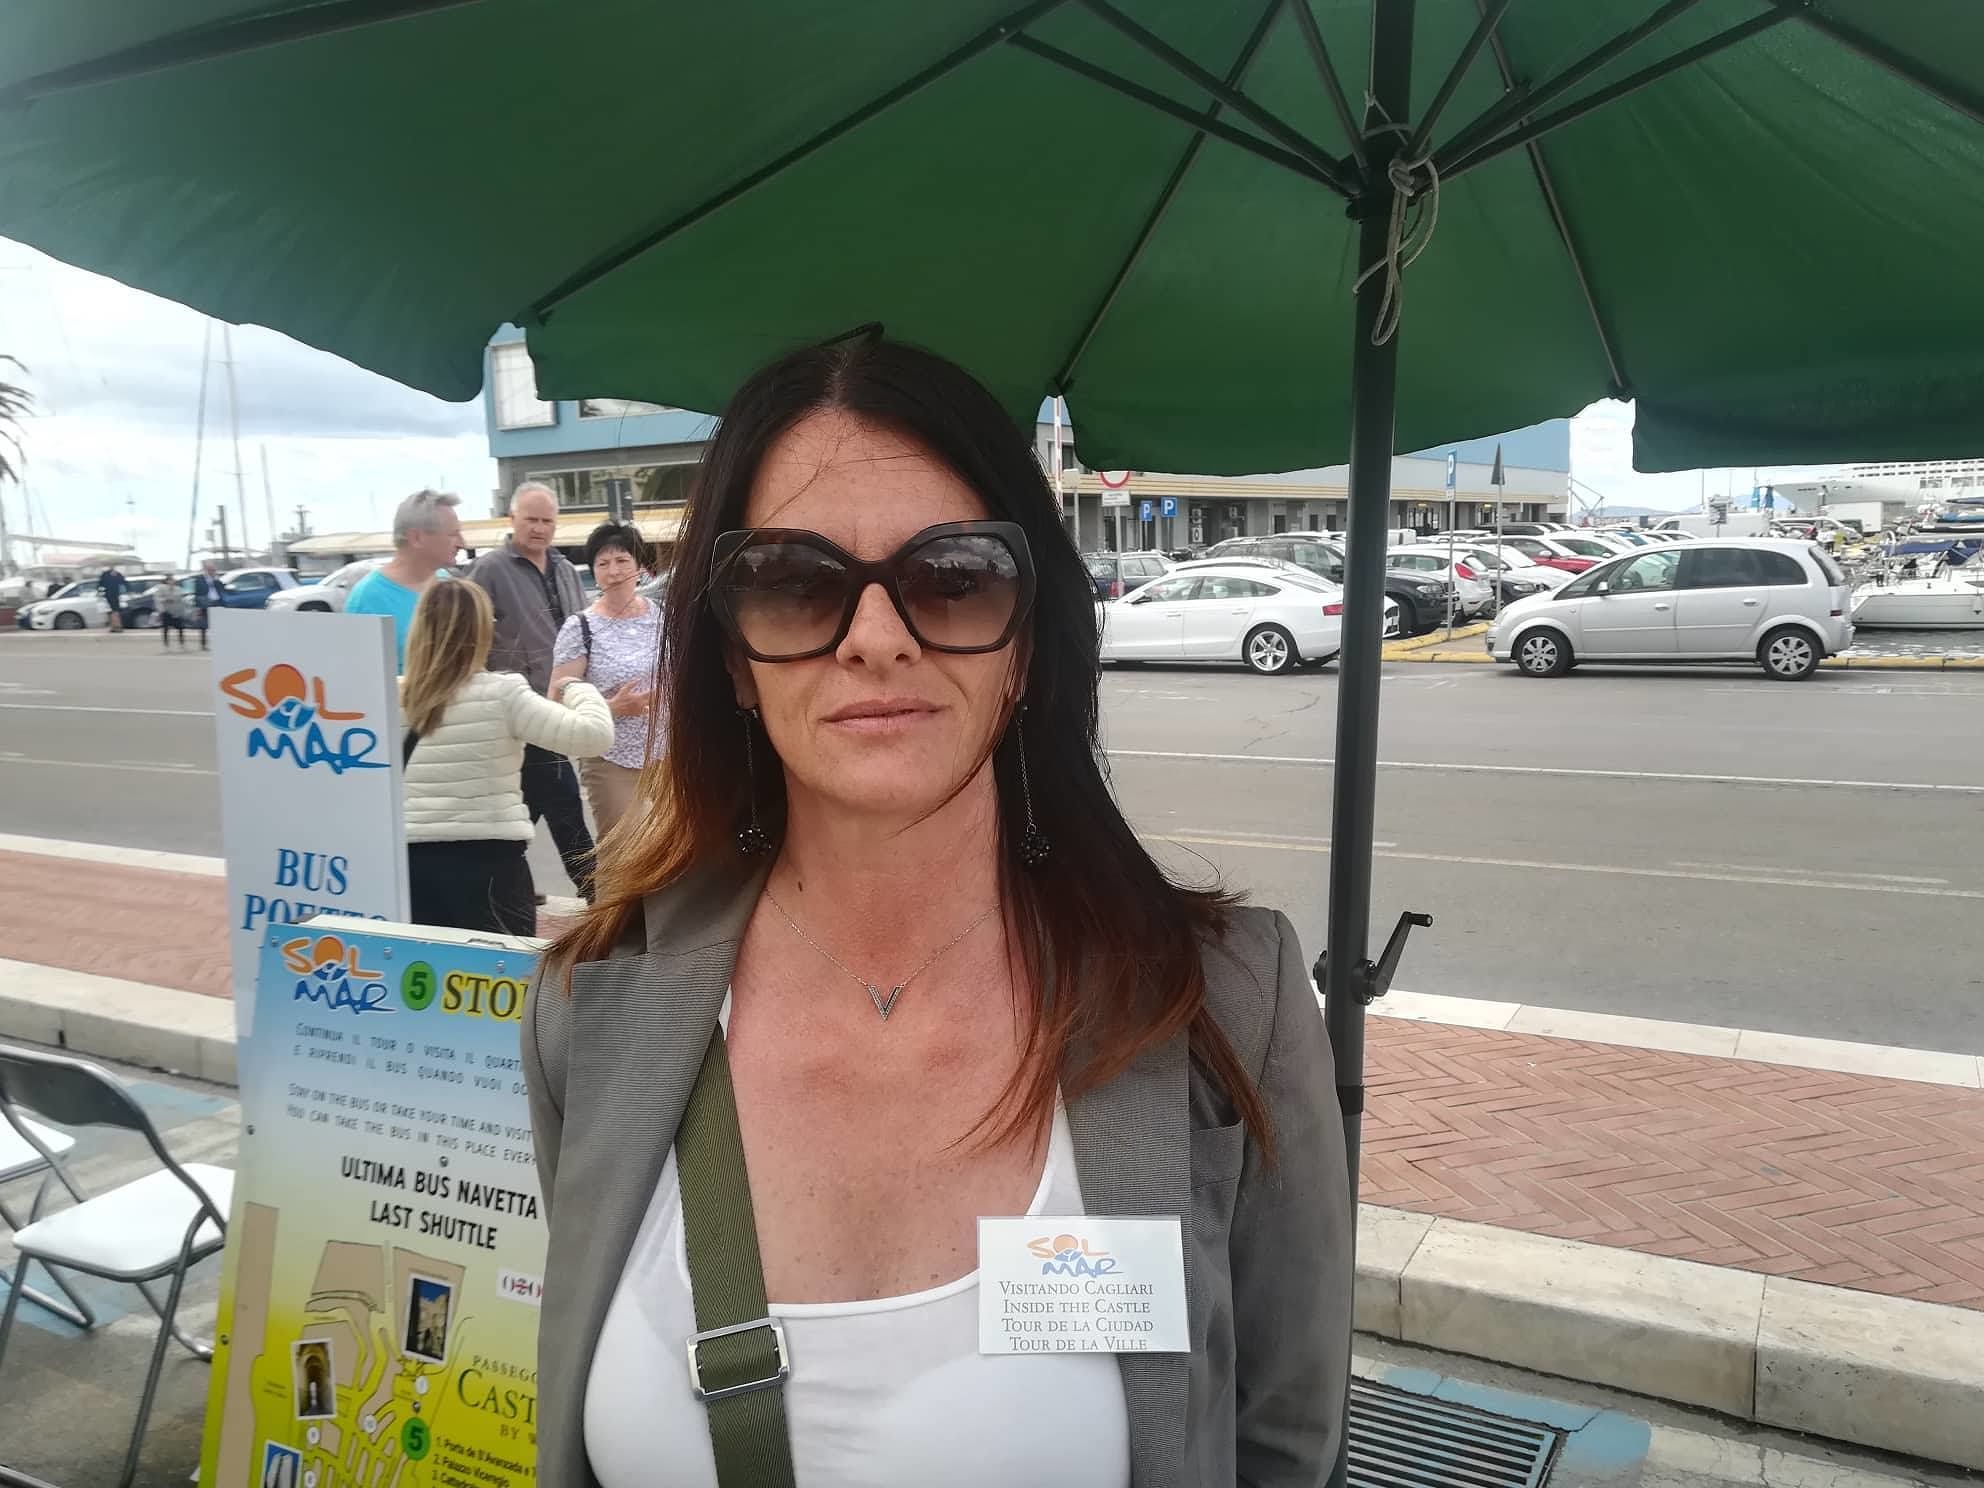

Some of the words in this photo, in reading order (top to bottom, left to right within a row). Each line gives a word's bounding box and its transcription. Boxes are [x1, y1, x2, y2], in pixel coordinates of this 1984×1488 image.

[1143, 503, 1151, 519] P
[1163, 499, 1175, 515] P
[219, 663, 366, 721] SOL
[247, 722, 392, 775] MAR
[274, 848, 349, 896] BUS
[282, 936, 384, 977] SOL
[294, 978, 397, 1015] MAR
[408, 971, 428, 1001] 5
[371, 1036, 397, 1051] TOUR
[424, 1045, 456, 1060] VISITA
[384, 1060, 408, 1075] BUS
[417, 1065, 464, 1084] QUANDO
[473, 1076, 502, 1091] VUOI
[328, 1092, 349, 1107] THE
[350, 1096, 370, 1111] BUS
[373, 1101, 388, 1114] OR
[391, 1104, 416, 1120] TAKE
[420, 1110, 448, 1124] YOUR
[450, 1115, 476, 1131] TIME
[479, 1121, 501, 1136] AND
[504, 1126, 534, 1142] VISIT
[310, 1109, 330, 1123] CAN
[336, 1115, 359, 1130] TAKE
[365, 1120, 384, 1135] THE
[391, 1126, 411, 1140] BUS
[436, 1134, 459, 1150] THIS
[464, 1141, 497, 1158] PLACE
[341, 1155, 406, 1189] ULTIMA
[414, 1170, 451, 1199] BUS
[456, 1179, 538, 1220] NAVETTA
[369, 1200, 413, 1229] LAST
[418, 1210, 498, 1250] SHUTTLE
[1026, 1233, 1111, 1259] SOL
[1041, 1256, 1125, 1278] MAR
[999, 1280, 1080, 1296] VISITANDO
[1084, 1279, 1153, 1296] CAGLIARI
[1003, 1299, 1053, 1314] INSIDE
[1060, 1302, 1090, 1313] THE
[1094, 1298, 1151, 1314] CASTLE
[1001, 1318, 1042, 1332] TOUR
[1049, 1320, 1068, 1332] DE
[1073, 1320, 1091, 1332] LA
[1095, 1317, 1154, 1332] CIUDAD
[1009, 1336, 1050, 1351] TOUR
[1055, 1338, 1075, 1351] DE
[1081, 1338, 1099, 1351] LA
[1104, 1336, 1148, 1351] VILLE
[458, 1368, 536, 1425] CAST
[407, 1425, 424, 1452] 5
[500, 1424, 520, 1440] BY
